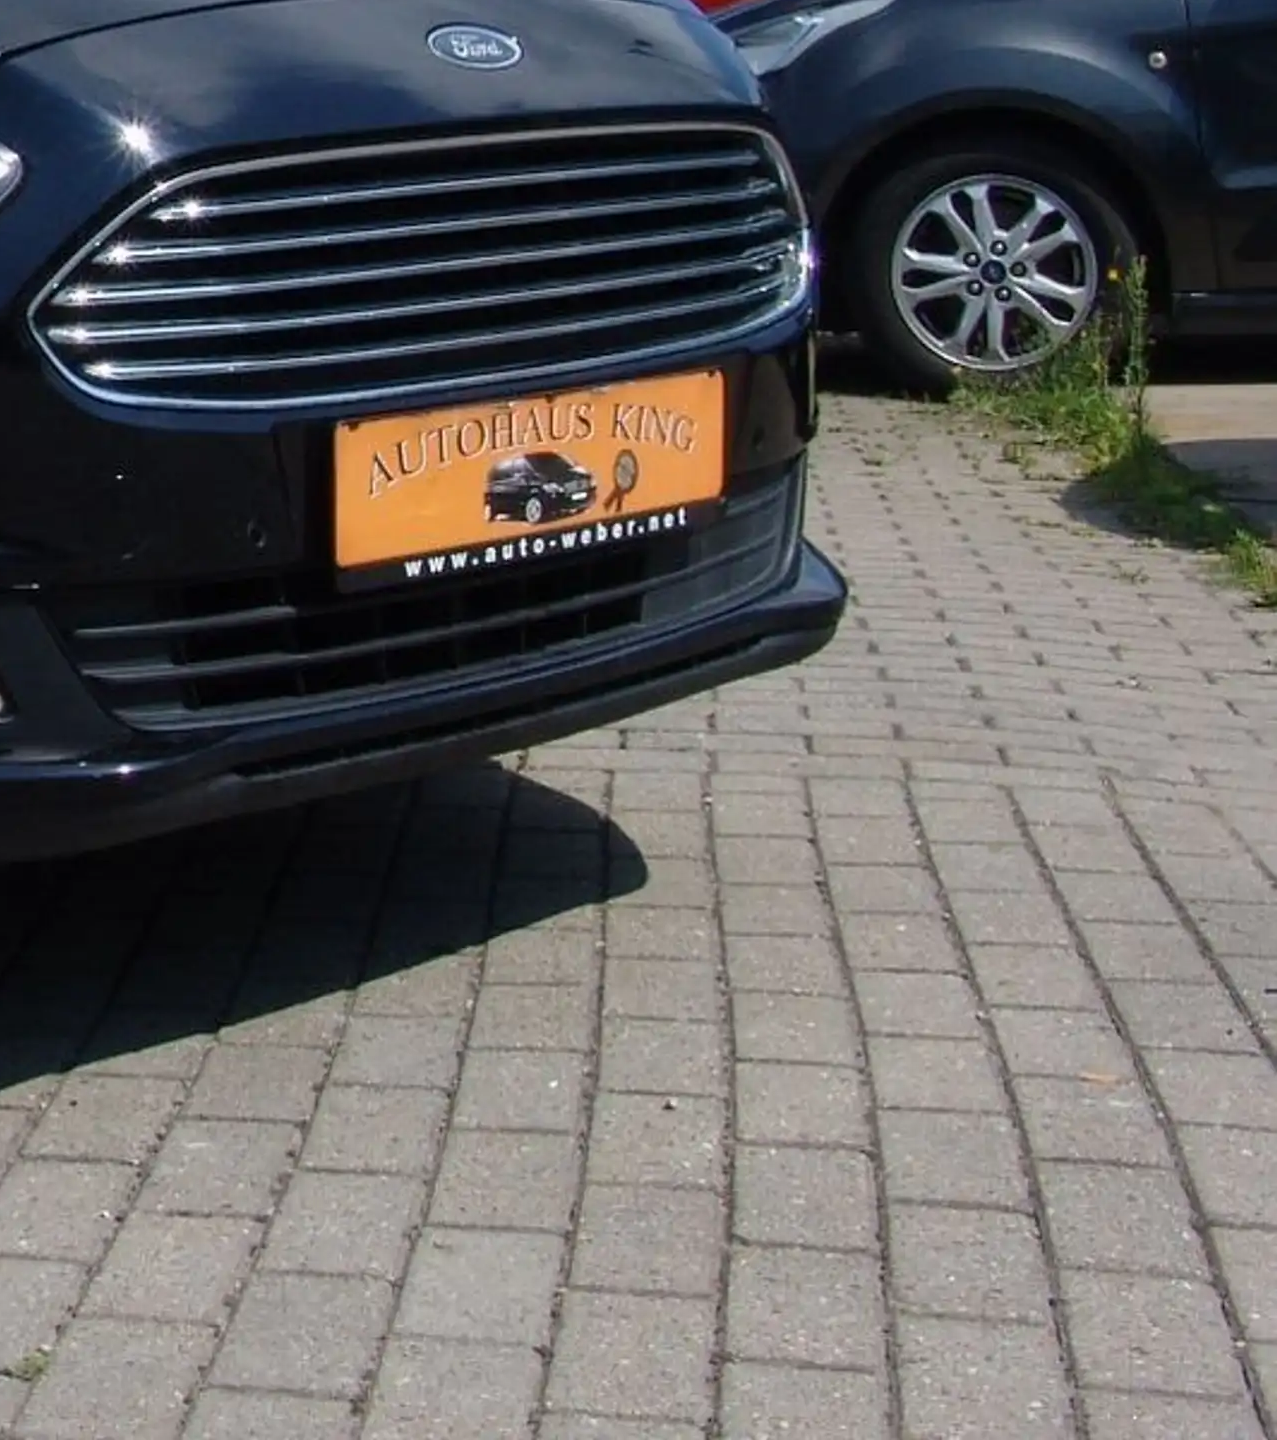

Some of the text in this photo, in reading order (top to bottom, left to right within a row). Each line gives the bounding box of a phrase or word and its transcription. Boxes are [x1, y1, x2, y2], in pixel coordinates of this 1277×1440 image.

[450, 32, 505, 58] Ford
[368, 402, 698, 498] AUTOHAUS KING
[404, 506, 687, 578] www.auto-weber.net
